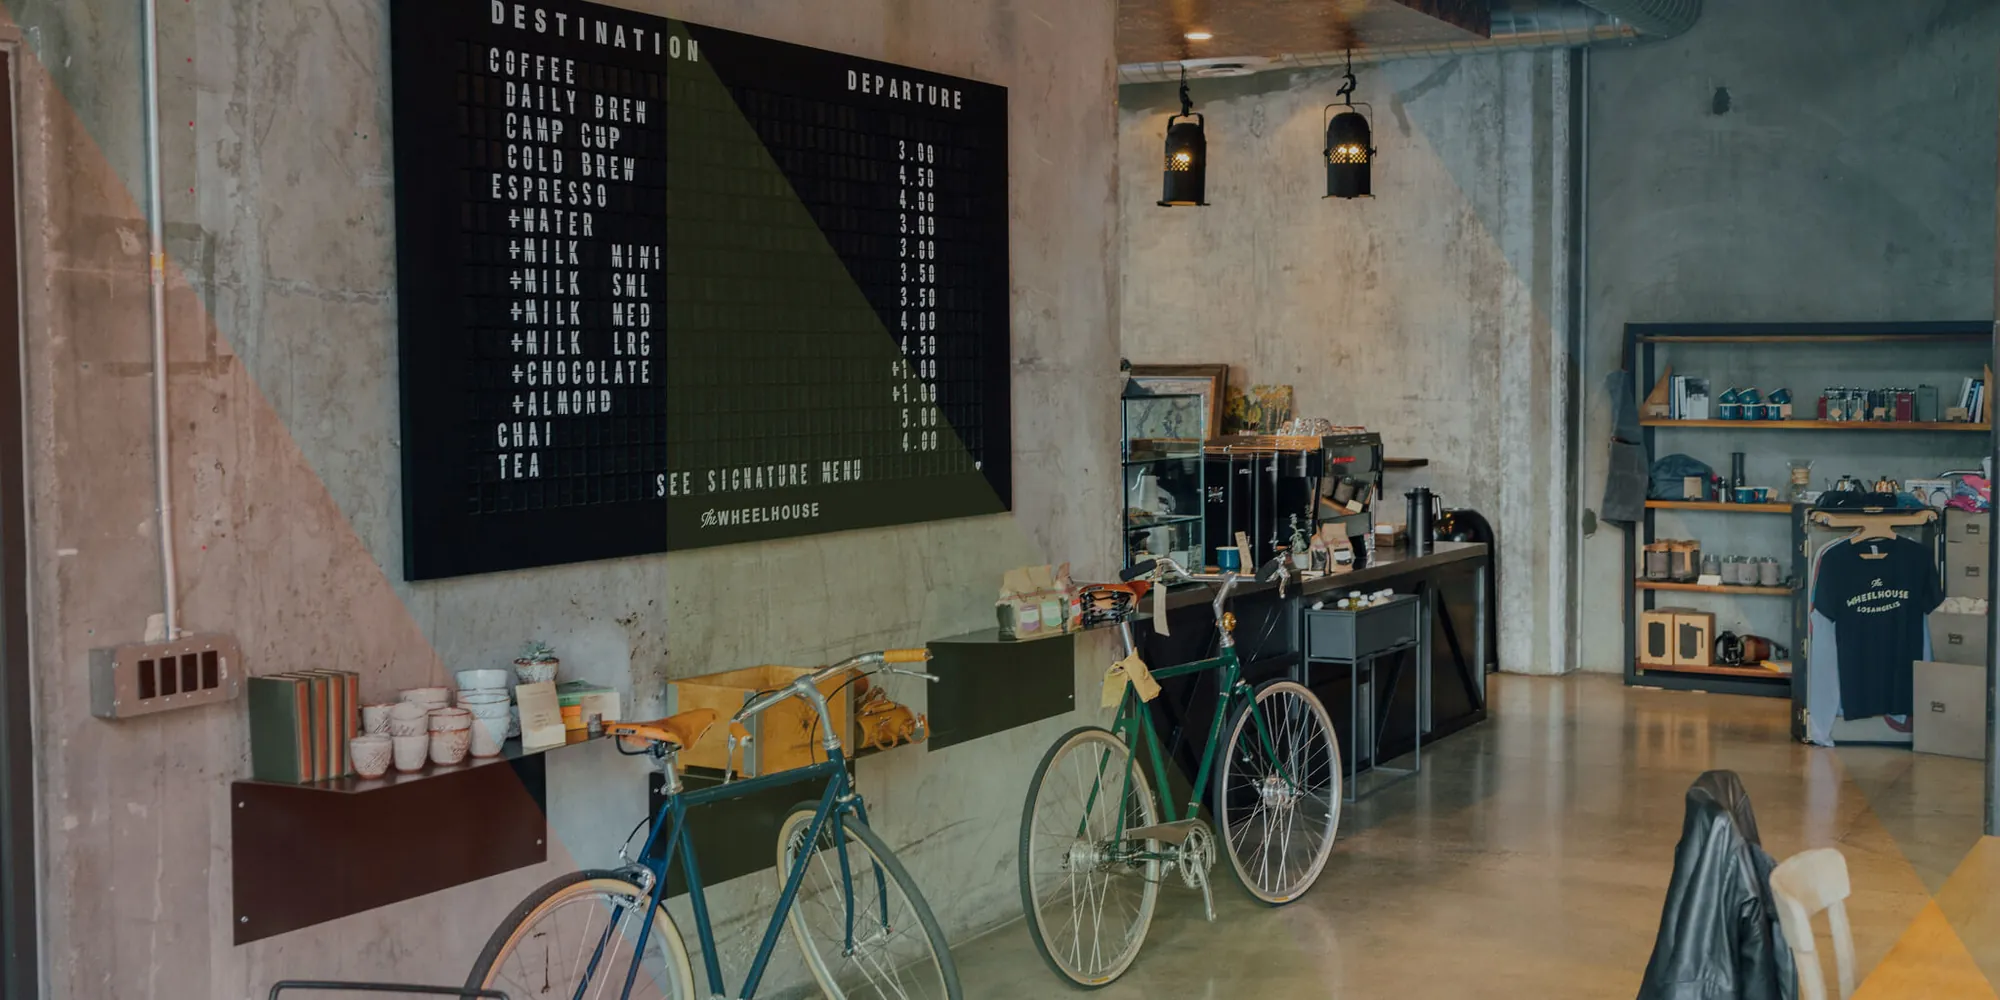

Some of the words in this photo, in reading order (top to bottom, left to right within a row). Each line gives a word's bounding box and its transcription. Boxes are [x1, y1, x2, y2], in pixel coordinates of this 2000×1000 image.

[491, 0, 699, 62] DESTINATION
[490, 48, 575, 84] COFFEE
[848, 70, 962, 110] DEPARTURE
[506, 82, 576, 115] DAILY
[596, 95, 645, 124] BREW
[506, 112, 564, 143] CAMP
[582, 123, 619, 149] CUP
[508, 144, 563, 173] COLD
[582, 152, 635, 181] BREW
[899, 140, 933, 163] 3.00
[900, 166, 933, 187] 4.50
[493, 174, 607, 208] ESPRESSO
[900, 189, 933, 212] 4.00
[509, 208, 592, 236] +WATER
[900, 214, 934, 235] 3.00
[509, 238, 578, 264] +MILK
[612, 244, 659, 269] MINI
[900, 238, 934, 259] 3.00
[510, 269, 579, 295] +MILK
[613, 273, 647, 297] SML
[901, 263, 934, 283] 3.50
[901, 287, 935, 307] 3.50
[511, 299, 579, 325] +MILK
[613, 303, 649, 327] MED
[901, 311, 935, 331] 4.00
[512, 330, 580, 355] +MILK
[614, 331, 649, 356] LRG
[902, 336, 935, 355] 4.50
[512, 360, 649, 385] +CHOCOLATE
[513, 390, 610, 416] +ALMOND
[903, 408, 936, 428] 5.00
[498, 422, 550, 447] CHAI
[903, 431, 936, 452] 4.00
[499, 453, 539, 479] TEA
[657, 472, 690, 496] SEE
[708, 464, 807, 491] SIGNATURE
[823, 460, 860, 483] MENU
[701, 509, 717, 528] The
[718, 503, 818, 525] WHEELHOUSE
[1871, 578, 1883, 588] The
[1846, 590, 1909, 607] WHEELHOUSE
